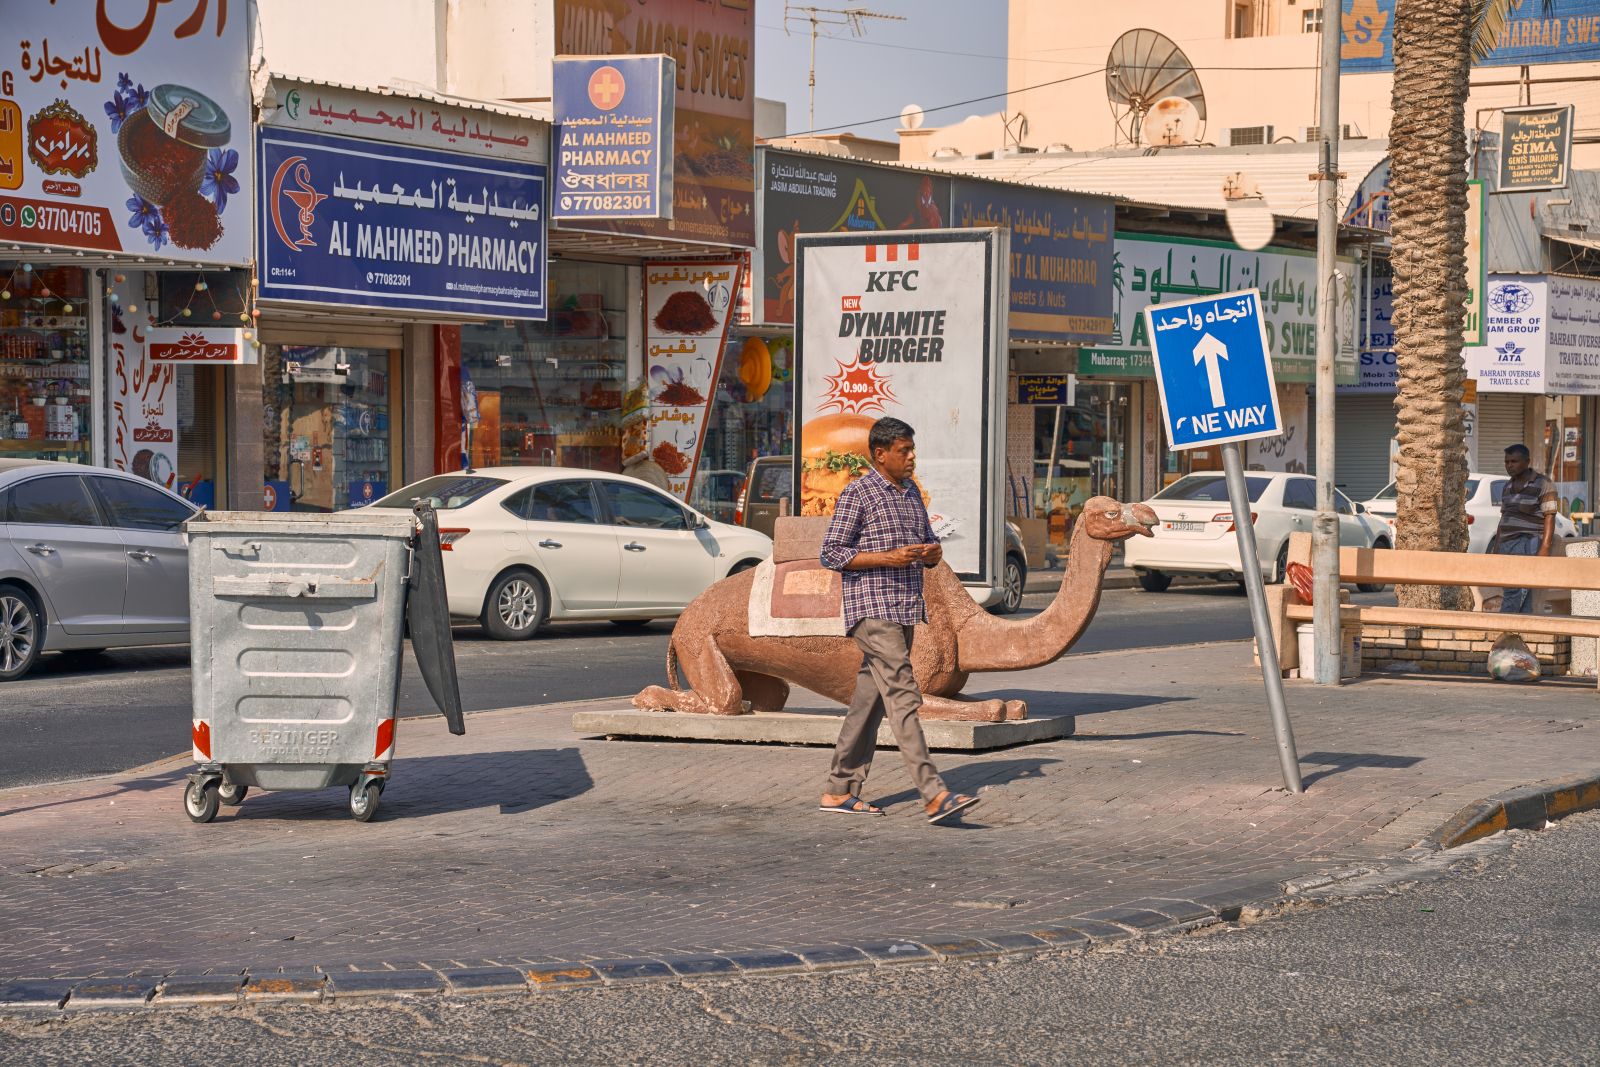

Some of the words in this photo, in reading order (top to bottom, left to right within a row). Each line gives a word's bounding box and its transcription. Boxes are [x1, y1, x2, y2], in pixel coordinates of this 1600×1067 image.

[1498, 19, 1560, 48] HARRAQ
[1568, 15, 1600, 46] SWE
[20, 38, 101, 90] للتجارة
[691, 29, 749, 101] SPICES
[309, 97, 424, 130] المحميد
[431, 111, 529, 149] صيدلية
[562, 133, 579, 147] AL
[583, 131, 651, 146] MAHMEED
[561, 150, 652, 166] PHARMACY
[1512, 141, 1557, 155] SIMA
[333, 170, 443, 211] المحميد
[771, 181, 787, 192] JASIM
[788, 183, 812, 195] ABDULLA
[813, 185, 837, 198] TRADING
[447, 177, 540, 229] صيدلية
[574, 195, 651, 210] 77082301
[37, 206, 101, 236] 37704705
[329, 220, 351, 257] AL
[357, 223, 443, 266] MAHMEED
[448, 233, 538, 274] PHARMACY
[374, 272, 411, 287] 77082301
[865, 270, 919, 292] KFC
[1024, 254, 1037, 280] AL
[1040, 256, 1097, 288] MUHARRAQ
[843, 298, 858, 309] NEW
[1010, 290, 1036, 306] weets
[1047, 291, 1066, 308] Nuts
[1156, 306, 1203, 333] واحد
[1206, 296, 1252, 325] اتجاه
[838, 310, 947, 338] DYNAMITE
[650, 340, 697, 358] نقين
[858, 337, 945, 363] BURGER
[1549, 332, 1577, 347] BAHRAIN
[1578, 334, 1600, 348] OVERSE
[1091, 352, 1128, 369] Muharraq:
[1130, 355, 1154, 367] 17344
[1559, 352, 1582, 366] TRAVEL
[1480, 370, 1507, 378] BAHRAIN
[1508, 370, 1541, 378] OVERSEAS
[1490, 378, 1513, 386] TRAVEL
[1514, 378, 1530, 386] S.C.C
[843, 381, 868, 394] 0.900
[1224, 404, 1268, 430] WAY
